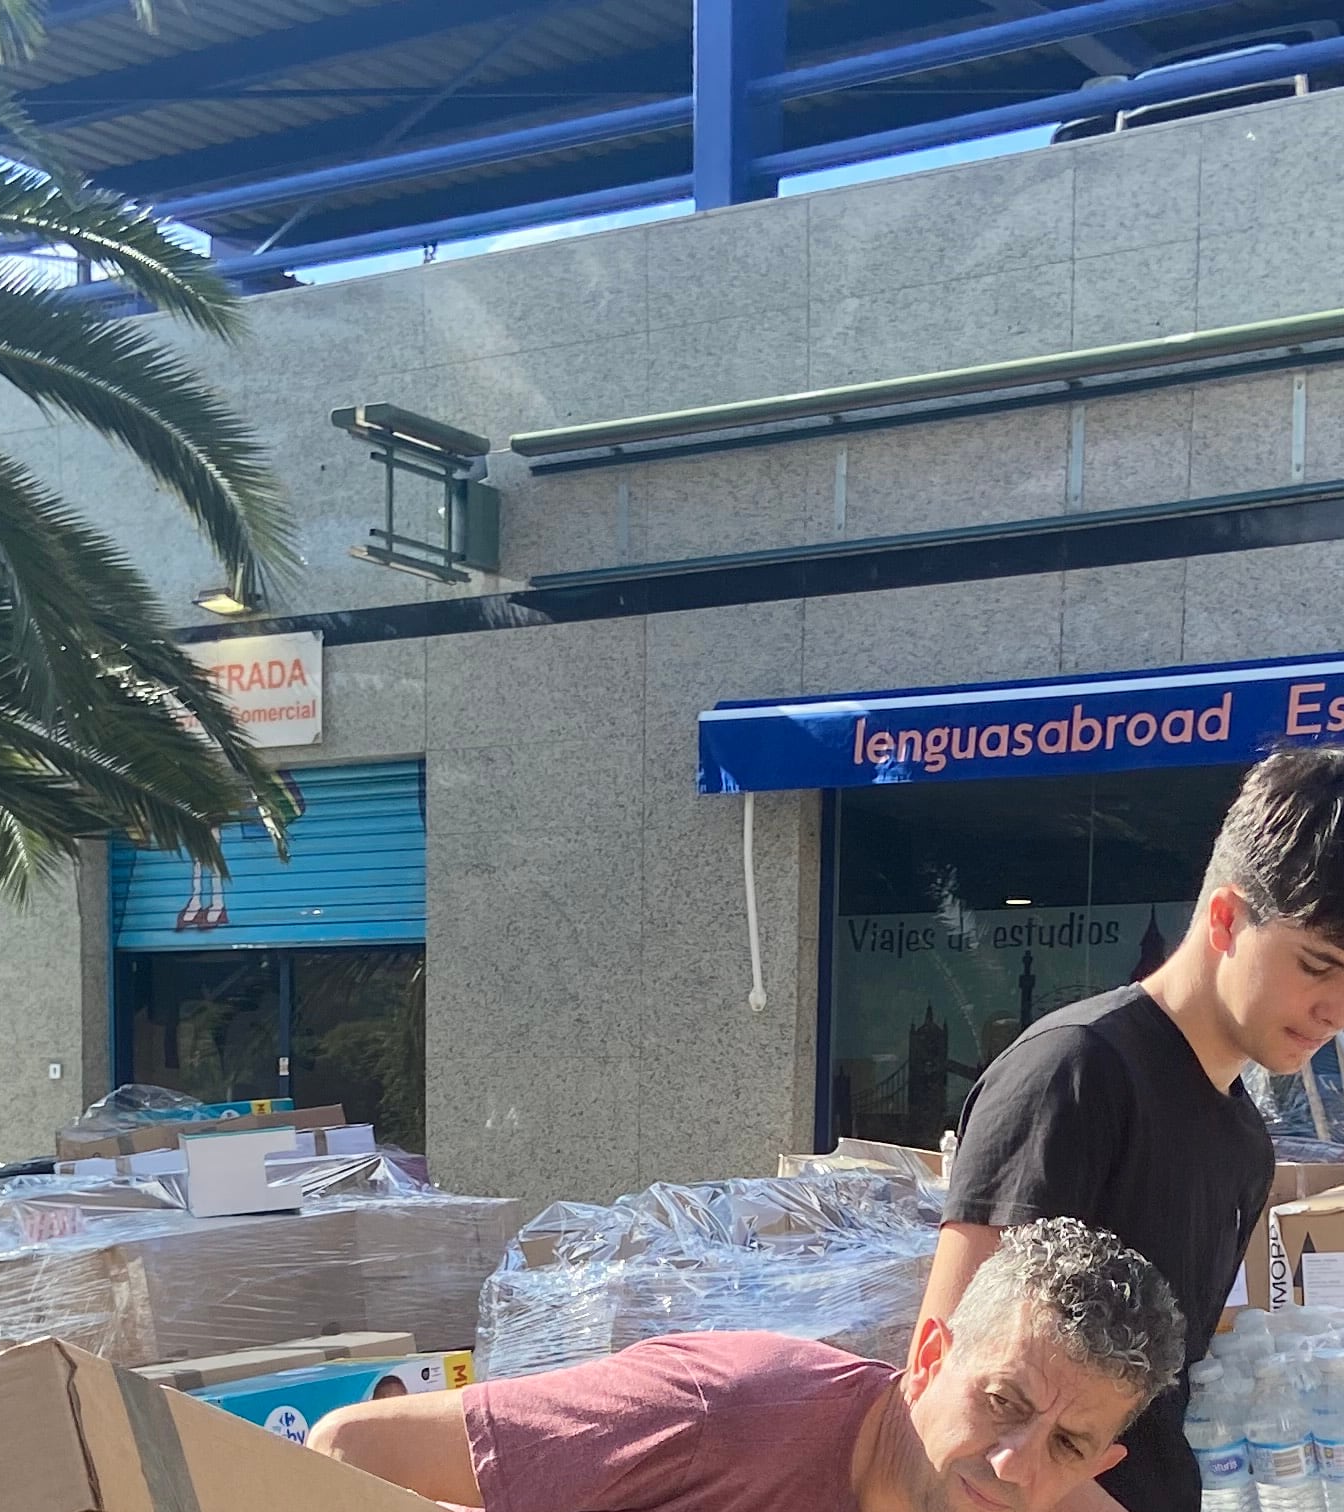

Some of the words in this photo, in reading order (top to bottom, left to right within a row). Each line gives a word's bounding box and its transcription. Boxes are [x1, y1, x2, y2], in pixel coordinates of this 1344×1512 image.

[209, 657, 307, 694] TRADA
[852, 692, 1232, 774] lenguasabroad
[847, 918, 935, 959] Viajes
[993, 911, 1120, 951] estudios
